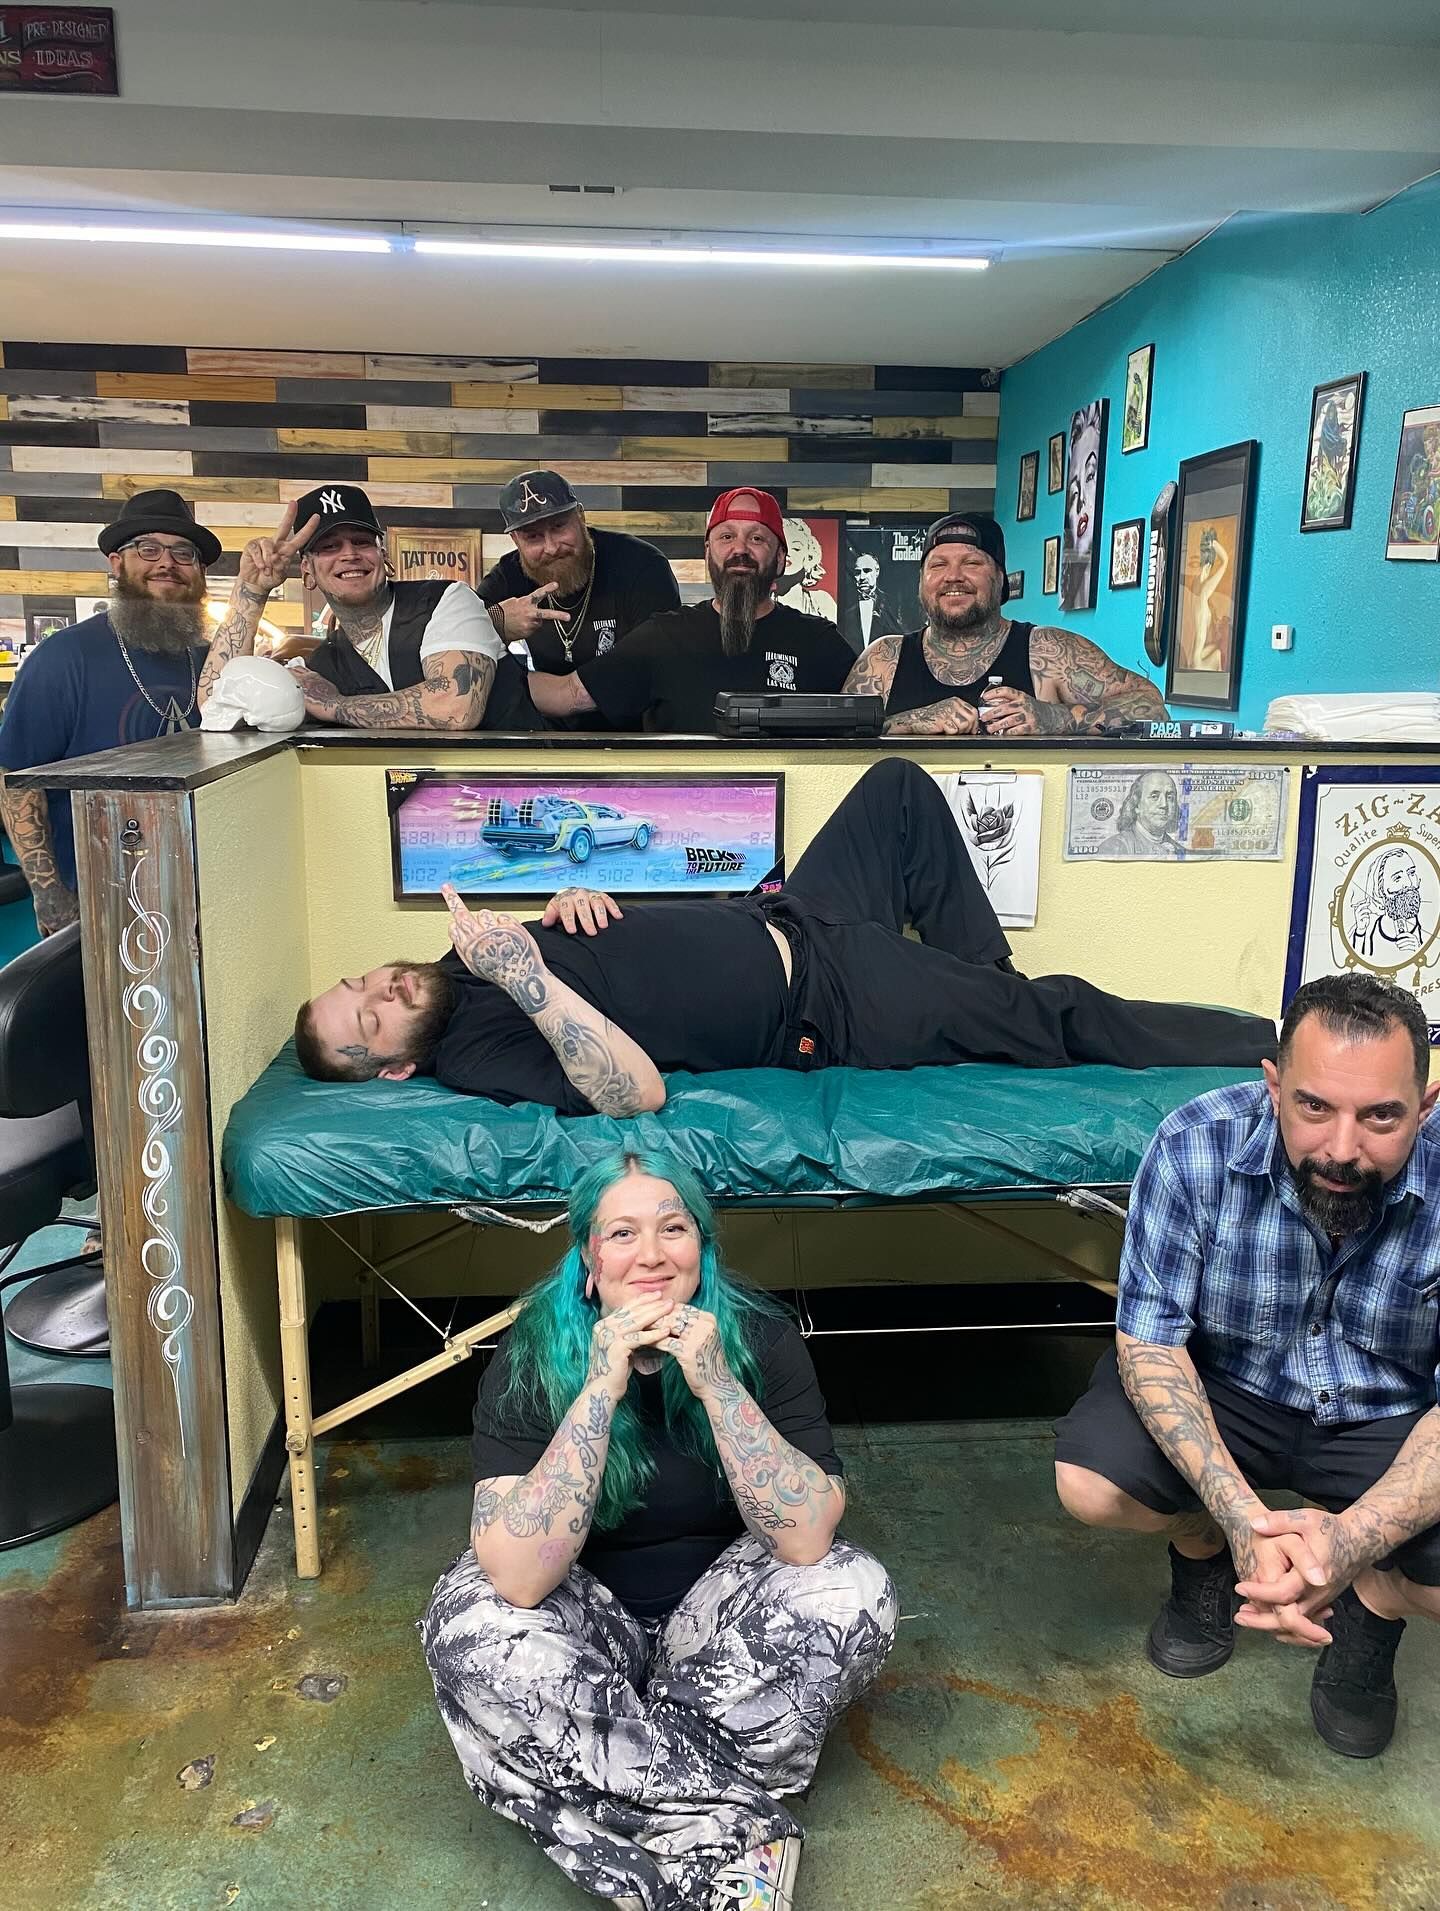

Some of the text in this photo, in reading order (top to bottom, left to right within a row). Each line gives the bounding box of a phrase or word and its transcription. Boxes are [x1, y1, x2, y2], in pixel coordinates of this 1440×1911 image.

[0, 50, 22, 65] NS
[34, 49, 94, 68] IDEAS
[319, 489, 346, 514] NY
[519, 479, 547, 513] A
[892, 531, 913, 545] The
[892, 545, 924, 561] Godfath
[401, 550, 468, 572] TATTOOS
[1145, 529, 1159, 629] RAMONES
[765, 651, 798, 667] ILLUMINATI
[767, 677, 778, 687] LAS
[779, 682, 797, 691] VEGAS
[1150, 722, 1182, 735] PAPA
[1075, 769, 1102, 779] 100
[1248, 771, 1276, 780] 100
[1335, 793, 1440, 837] ZIG-ZA
[685, 847, 728, 862] BACK
[1072, 845, 1099, 854] 100
[697, 862, 746, 874] FUTURE
[1414, 978, 1440, 998] ERES
